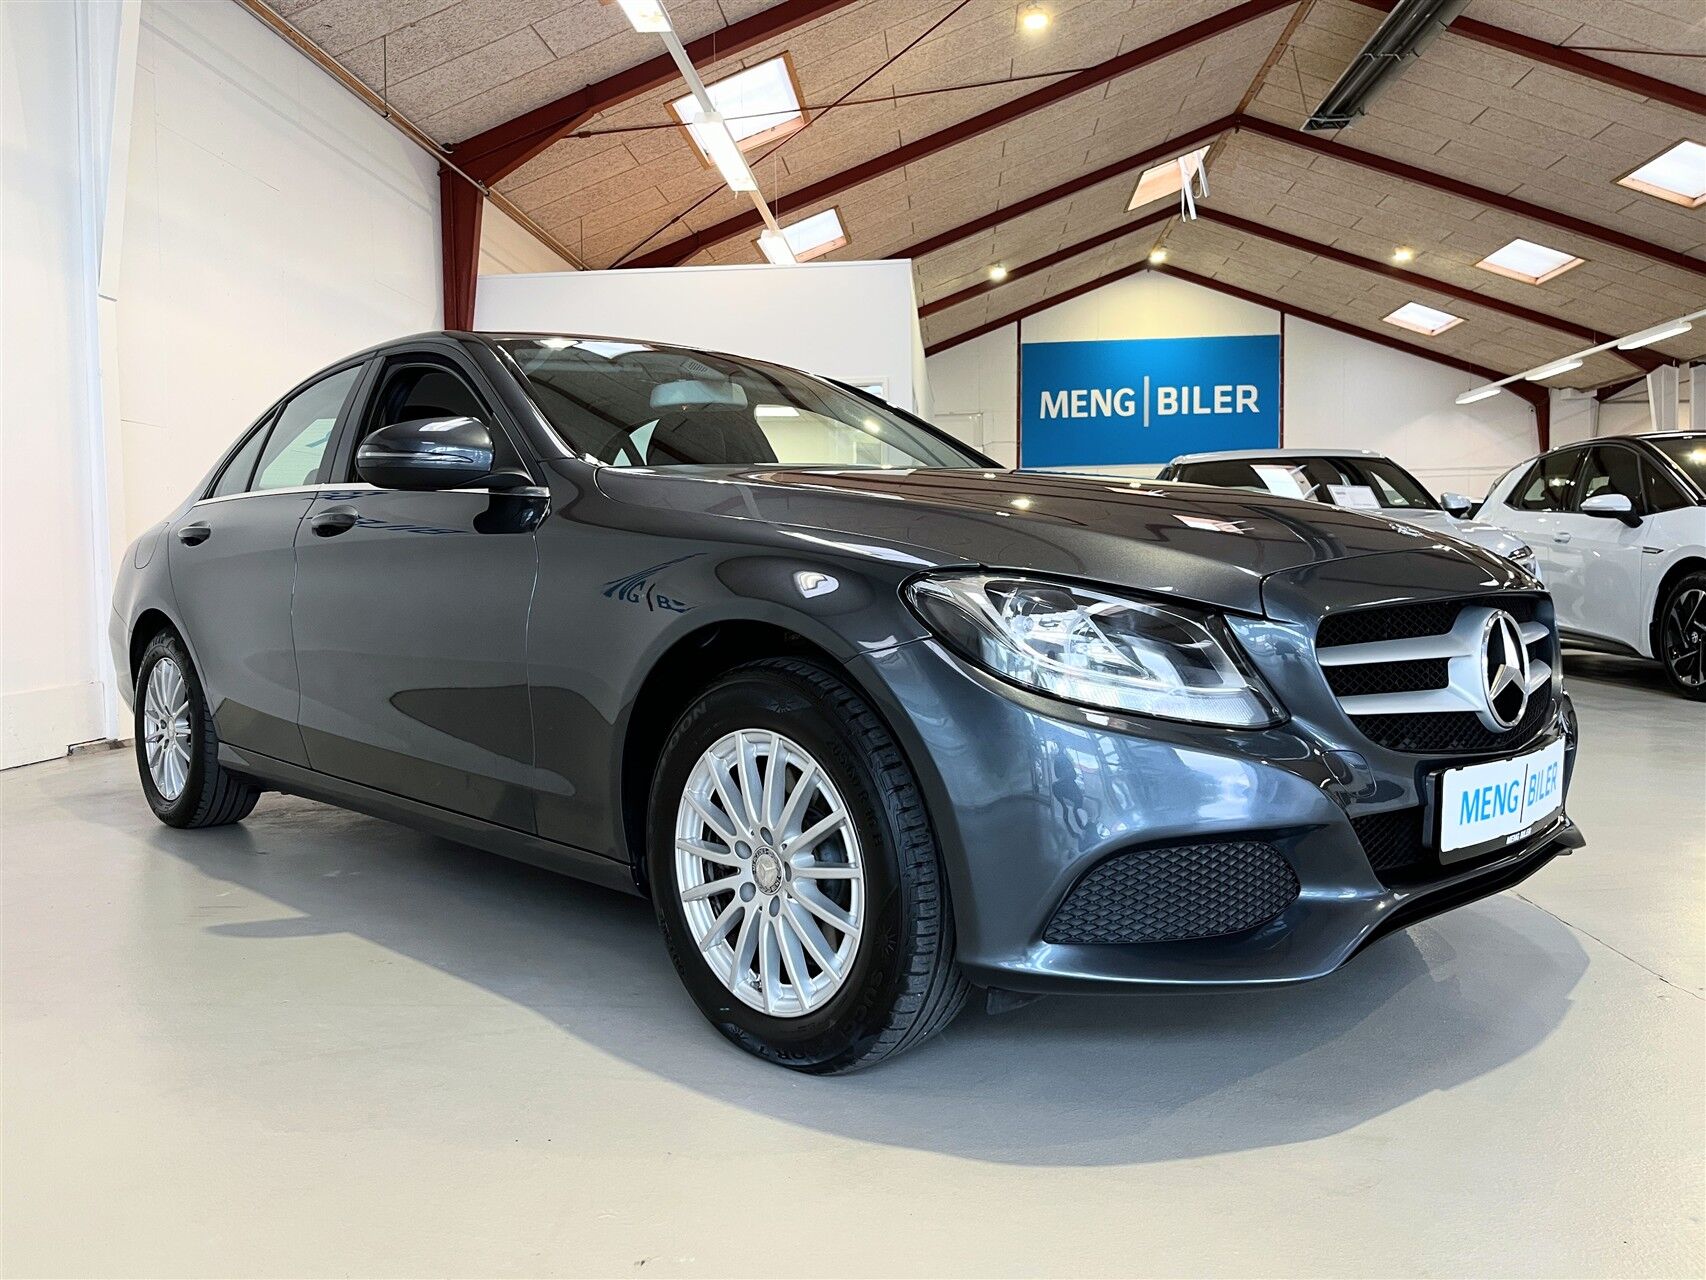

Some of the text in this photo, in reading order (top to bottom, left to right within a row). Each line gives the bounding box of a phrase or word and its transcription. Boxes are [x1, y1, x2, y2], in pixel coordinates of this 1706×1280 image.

[1039, 384, 1260, 419] MENG BILER
[1459, 761, 1558, 826] MENG BILER
